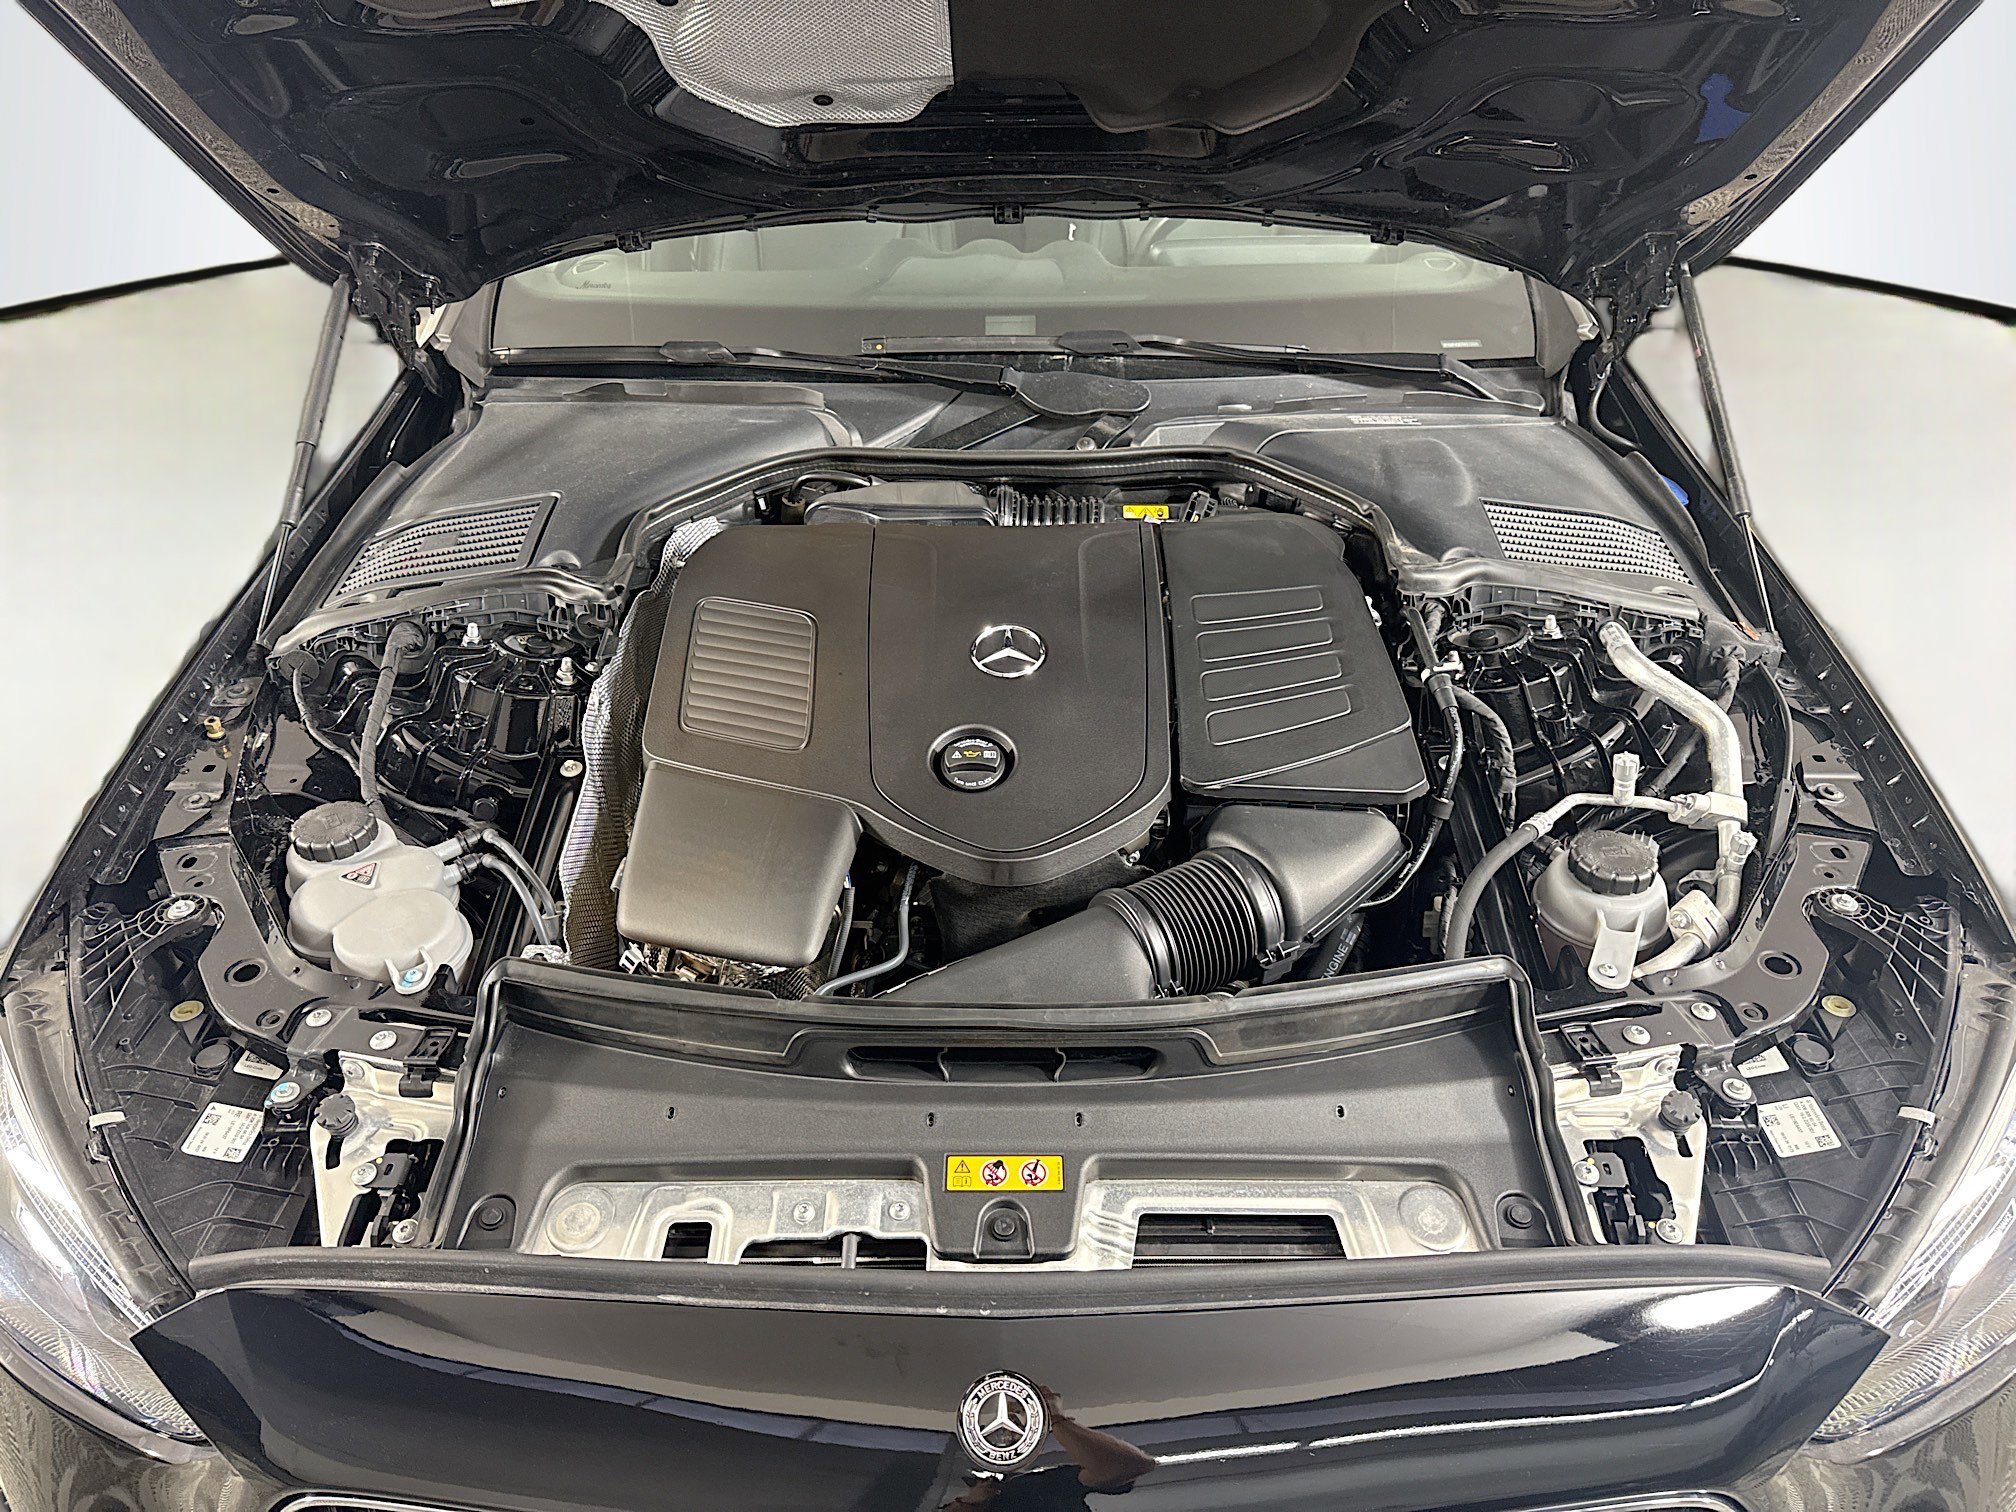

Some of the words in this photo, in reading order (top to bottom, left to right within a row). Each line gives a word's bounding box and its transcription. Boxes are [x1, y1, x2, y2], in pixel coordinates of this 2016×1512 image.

[953, 776, 965, 785] Turn
[978, 776, 994, 786] CLICK
[1320, 943, 1349, 979] NGINE
[976, 1380, 1028, 1399] MERCEDES
[988, 1449, 1018, 1461] BENZ
